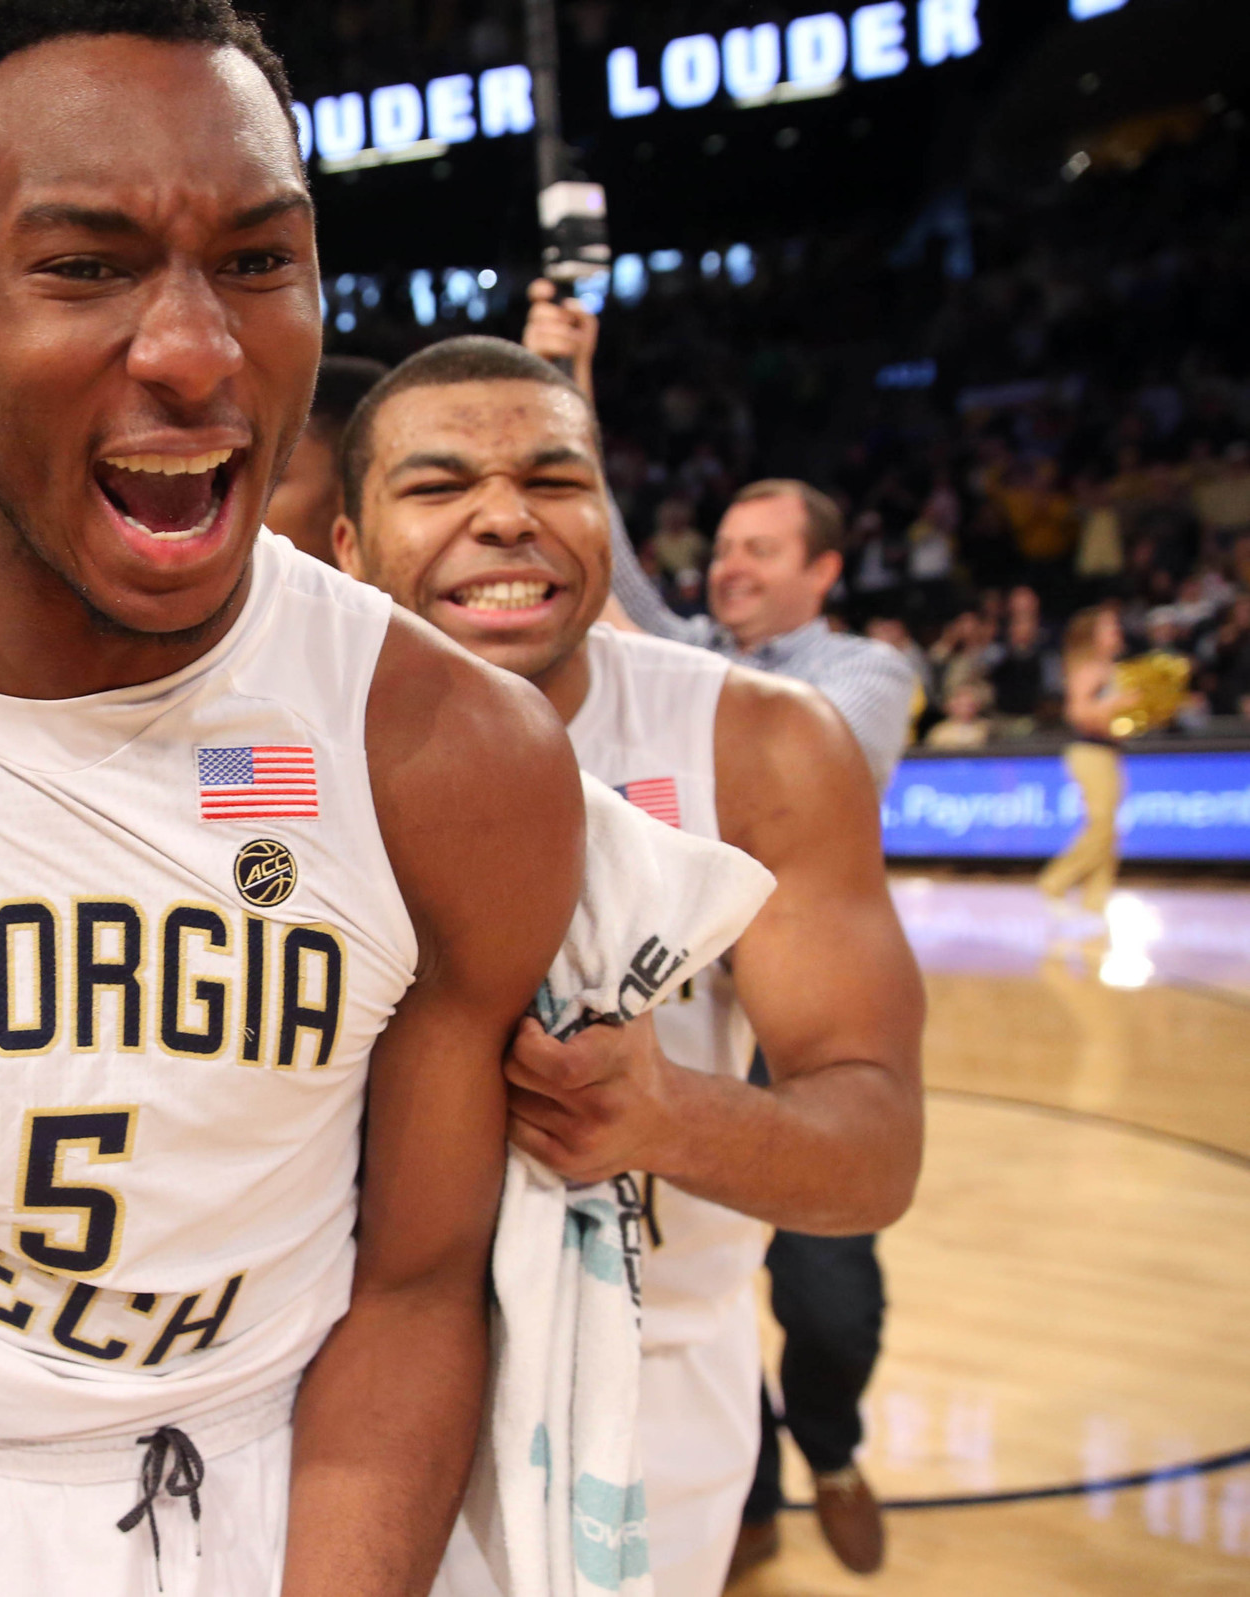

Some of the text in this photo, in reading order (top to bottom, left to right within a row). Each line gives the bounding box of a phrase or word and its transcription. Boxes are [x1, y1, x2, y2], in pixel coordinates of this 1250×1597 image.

[606, 0, 982, 119] LOUDER
[244, 851, 291, 886] ACC
[12, 1104, 139, 1280] 5
